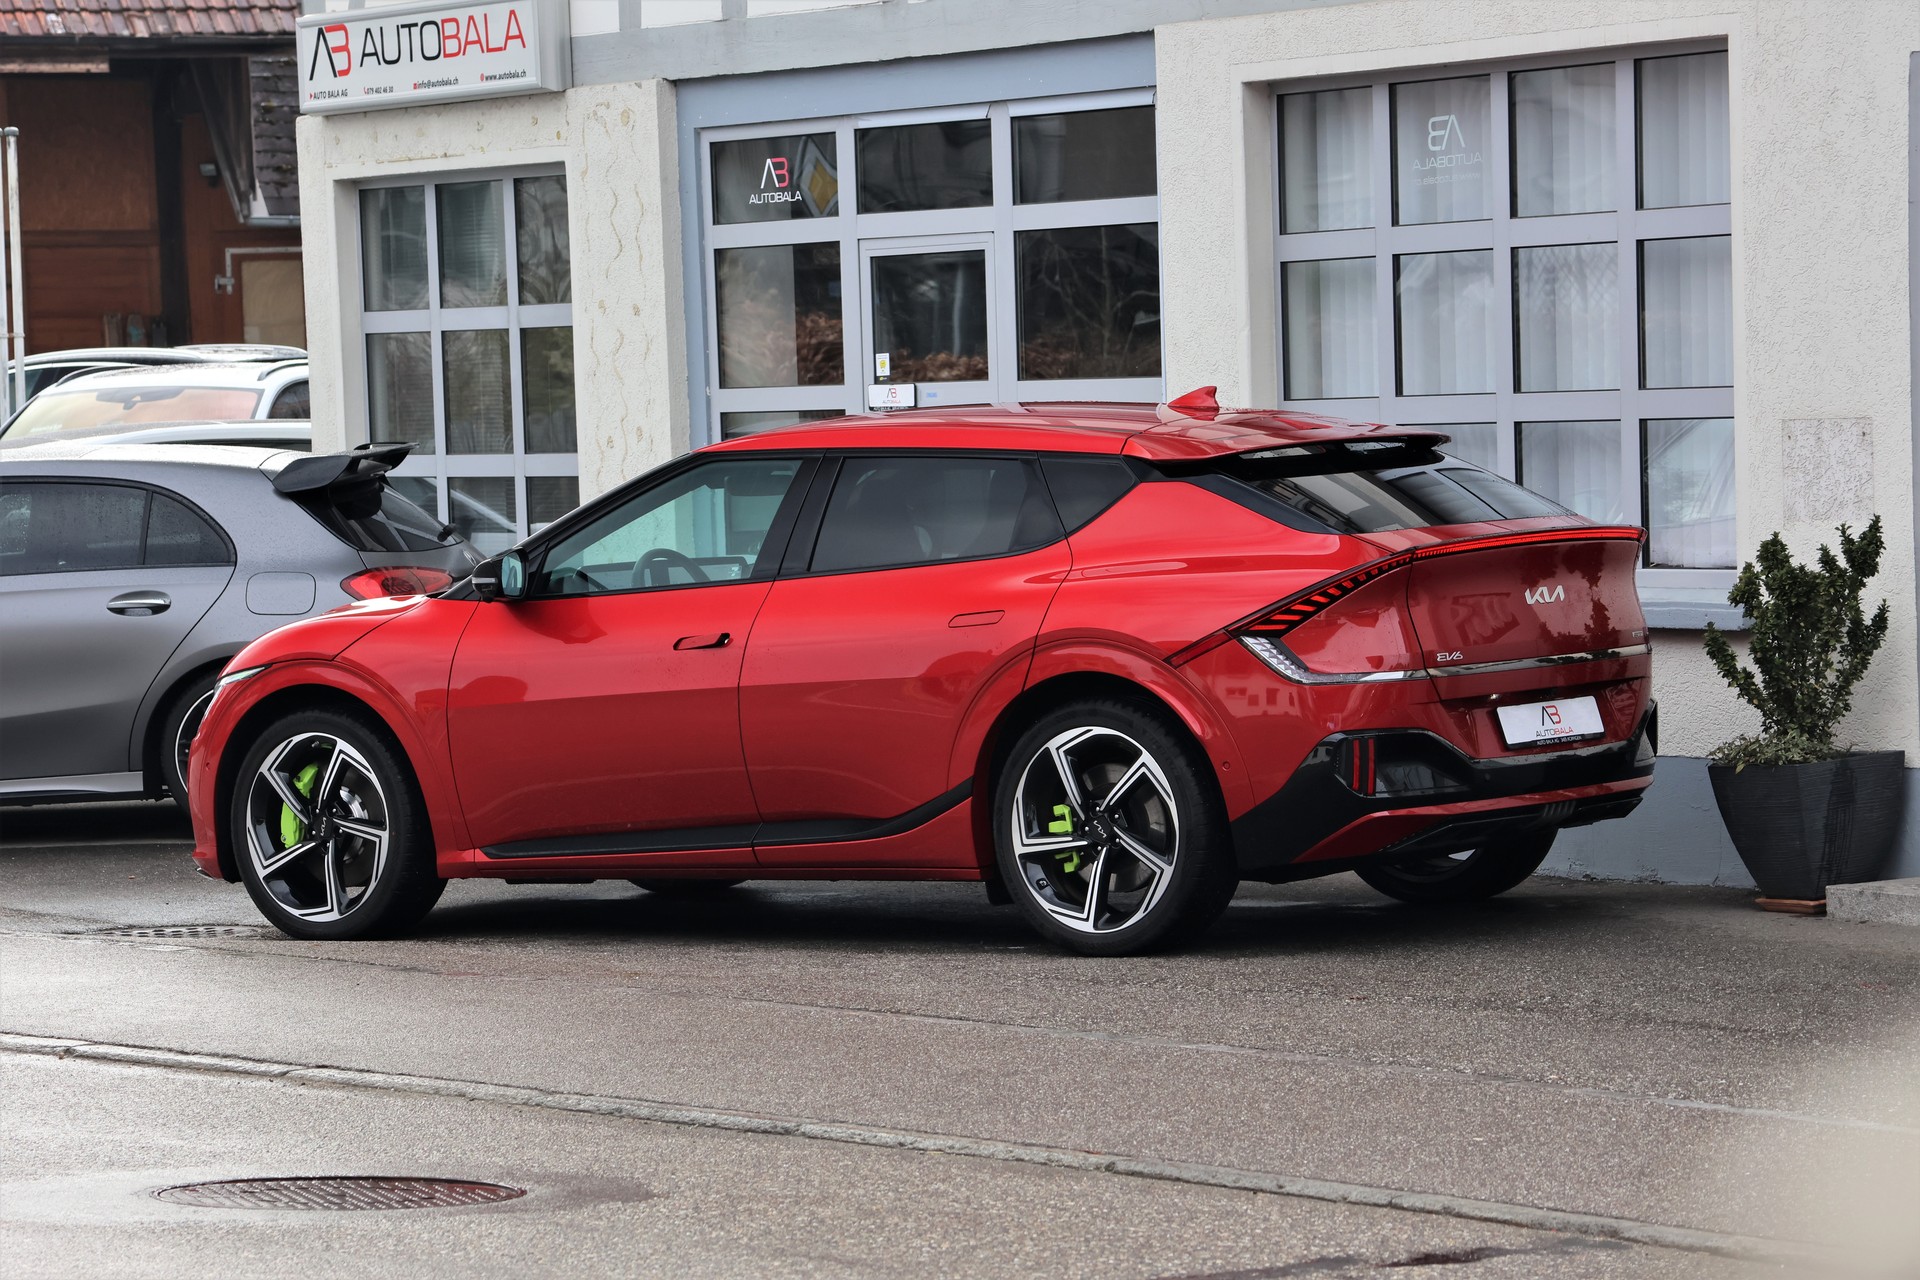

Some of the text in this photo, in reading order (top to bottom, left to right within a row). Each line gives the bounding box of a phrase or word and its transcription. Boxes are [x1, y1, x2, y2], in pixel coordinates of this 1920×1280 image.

[360, 9, 527, 68] AUTOBALA
[484, 69, 527, 82] www.autobala.ch
[417, 76, 459, 89] info@autobala.ch
[313, 88, 348, 100] AUTO BALA AG
[366, 87, 374, 95] 079
[383, 86, 388, 94] 46
[749, 190, 802, 205] AUTOBALA
[1524, 584, 1565, 605] KIA
[1436, 651, 1464, 662] EV6
[1536, 726, 1574, 737] AUTOBALA
